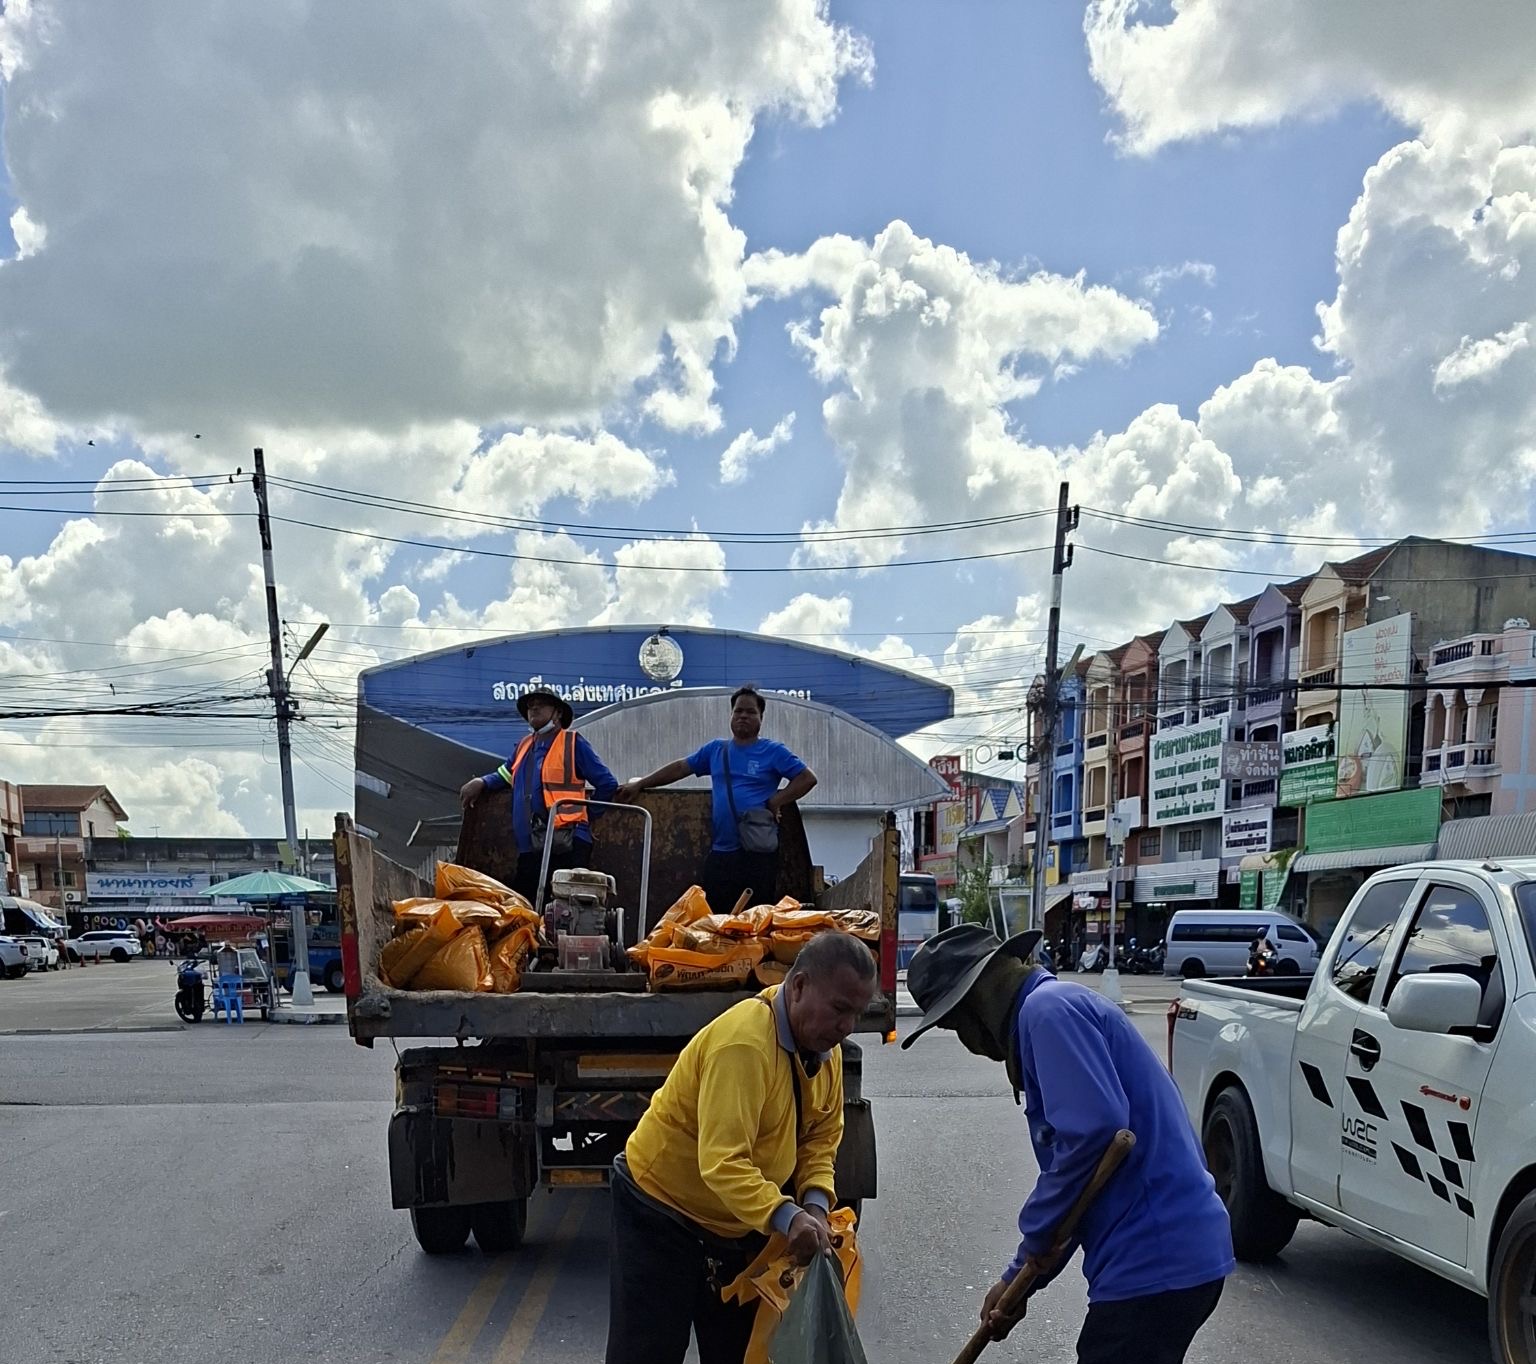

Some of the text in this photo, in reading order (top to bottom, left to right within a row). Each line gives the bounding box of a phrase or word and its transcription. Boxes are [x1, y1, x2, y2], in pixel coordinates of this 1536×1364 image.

[1240, 743, 1280, 761] ทำฟัน
[1245, 762, 1278, 777] จัดฟัน
[97, 874, 195, 889] นานาทอยส์
[1342, 1112, 1378, 1145] WRC
